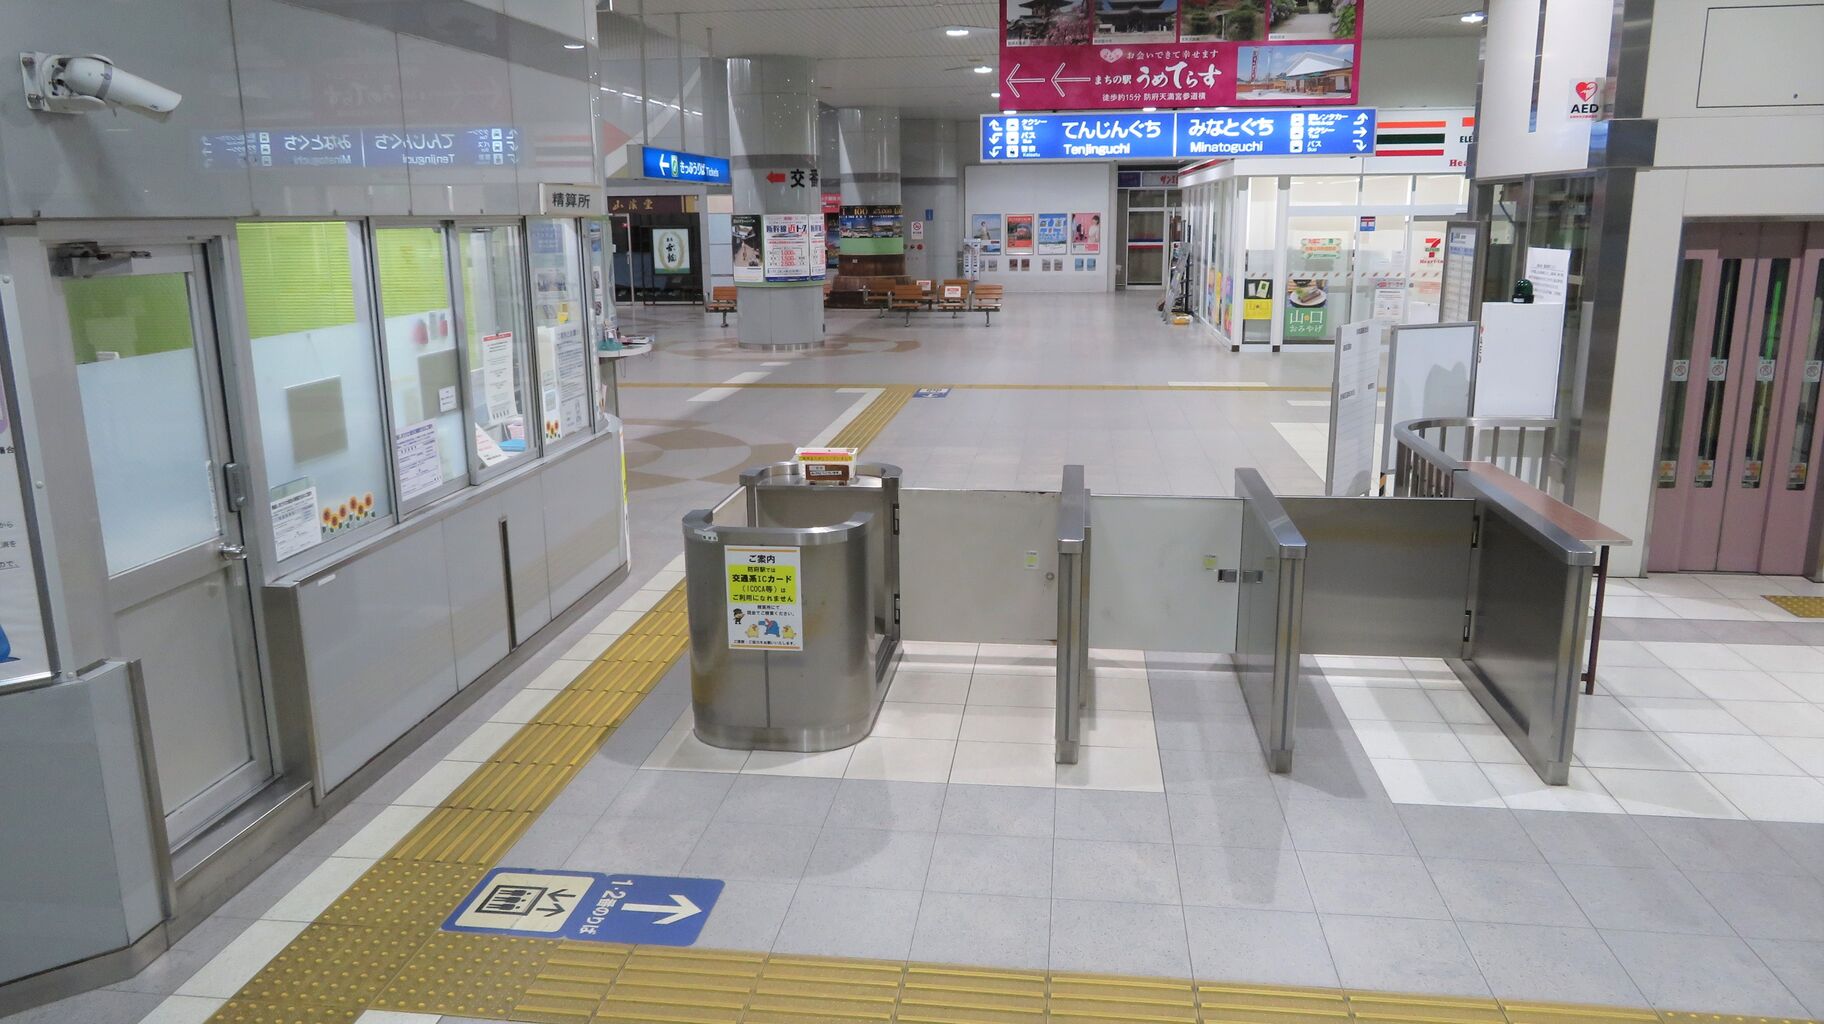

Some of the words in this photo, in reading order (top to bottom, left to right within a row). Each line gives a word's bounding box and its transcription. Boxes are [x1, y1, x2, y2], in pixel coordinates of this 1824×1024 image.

[1094, 74, 1132, 85] まちの駅
[1136, 61, 1222, 89] うめてらす
[1570, 103, 1600, 114] AED
[1061, 119, 1161, 139] てんじんぐち
[1188, 117, 1274, 137] みなとぐち
[1063, 143, 1130, 156] Tenjinguchi
[1190, 140, 1263, 154] Minatoguchi
[679, 160, 705, 176] きっぷうりば
[790, 168, 819, 188] 交番
[551, 191, 591, 208] 精算所
[1289, 324, 1324, 334] おみやげ
[748, 554, 776, 564] ご案内
[732, 574, 792, 583] 交通系ICカード
[732, 594, 794, 602] ご利用になれません
